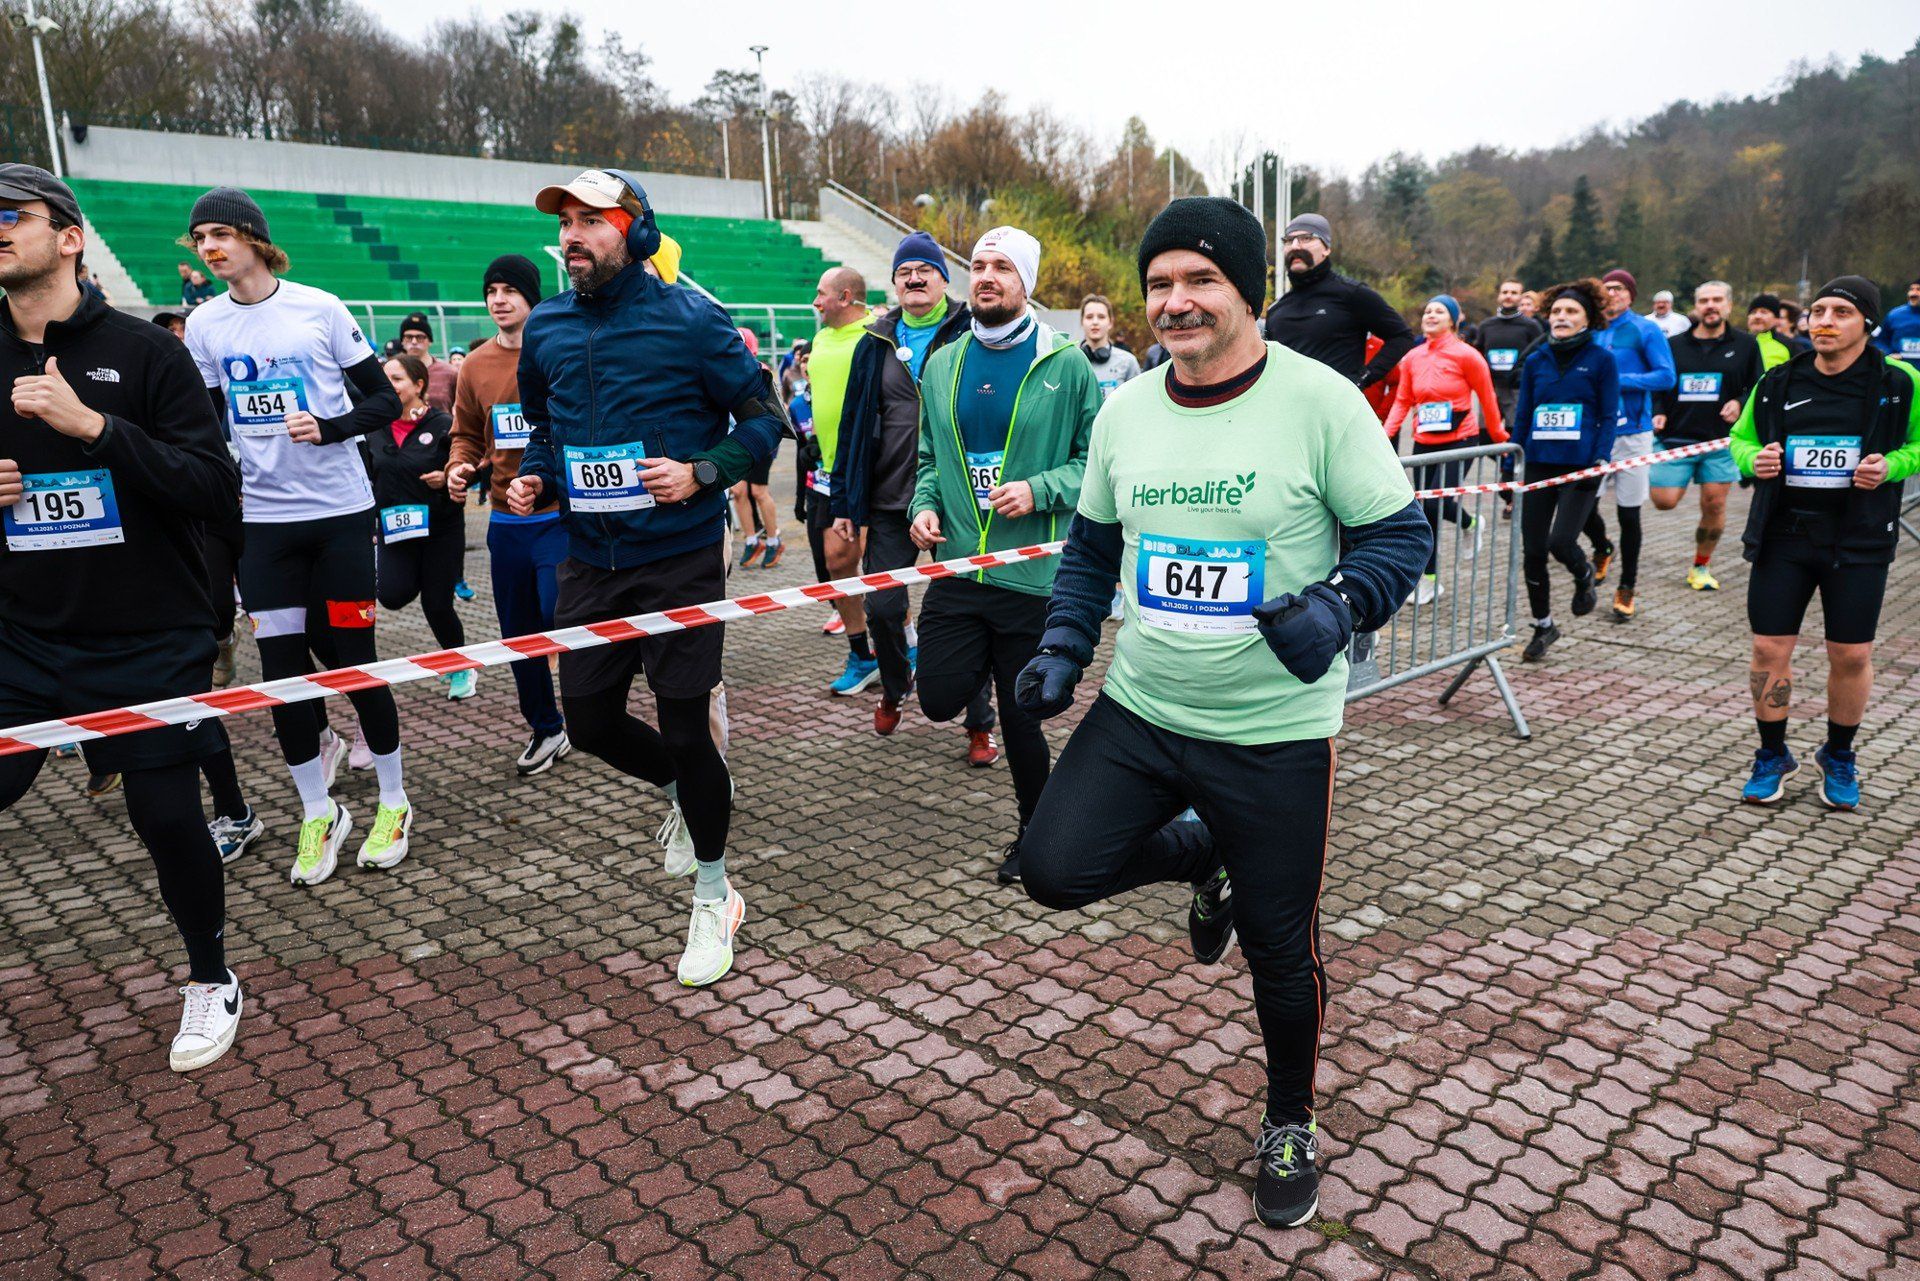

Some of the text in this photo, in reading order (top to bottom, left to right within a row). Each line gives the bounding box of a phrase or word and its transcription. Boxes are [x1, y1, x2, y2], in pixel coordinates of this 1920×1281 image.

[247, 394, 285, 415] 454
[1543, 413, 1565, 426] 351
[1806, 449, 1847, 468] 266
[581, 463, 624, 488] 689
[970, 466, 1001, 489] 669
[1131, 480, 1243, 507] Herbalife
[26, 491, 85, 521] 195
[1231, 506, 1242, 514] life
[395, 513, 411, 527] 58
[1165, 561, 1228, 600] 647
[1161, 601, 1189, 610] 16.11.2025
[1199, 605, 1230, 613] POZNAŃ
